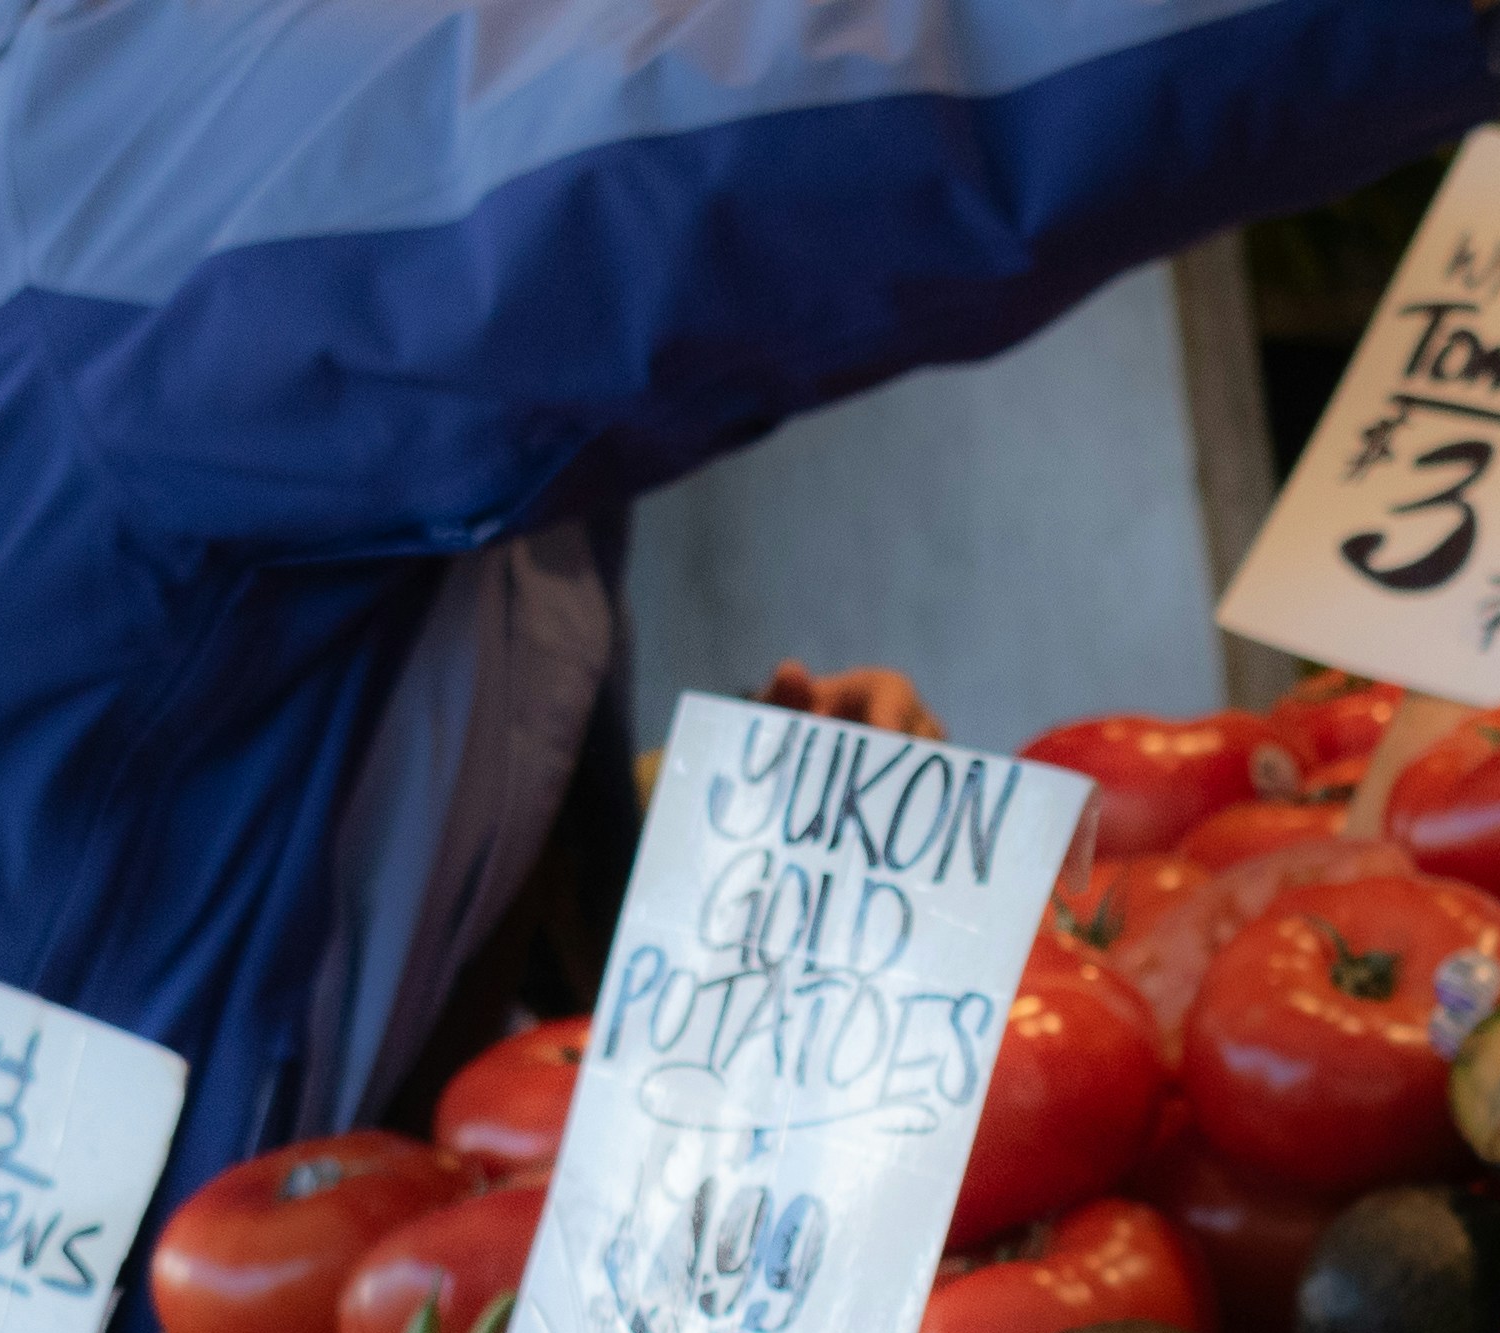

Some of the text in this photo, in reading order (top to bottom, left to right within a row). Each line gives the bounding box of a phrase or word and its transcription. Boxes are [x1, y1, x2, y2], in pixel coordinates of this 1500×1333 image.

[708, 715, 1024, 885] YUKON
[699, 848, 912, 975] GOLD
[602, 943, 993, 1108] POTATOES
